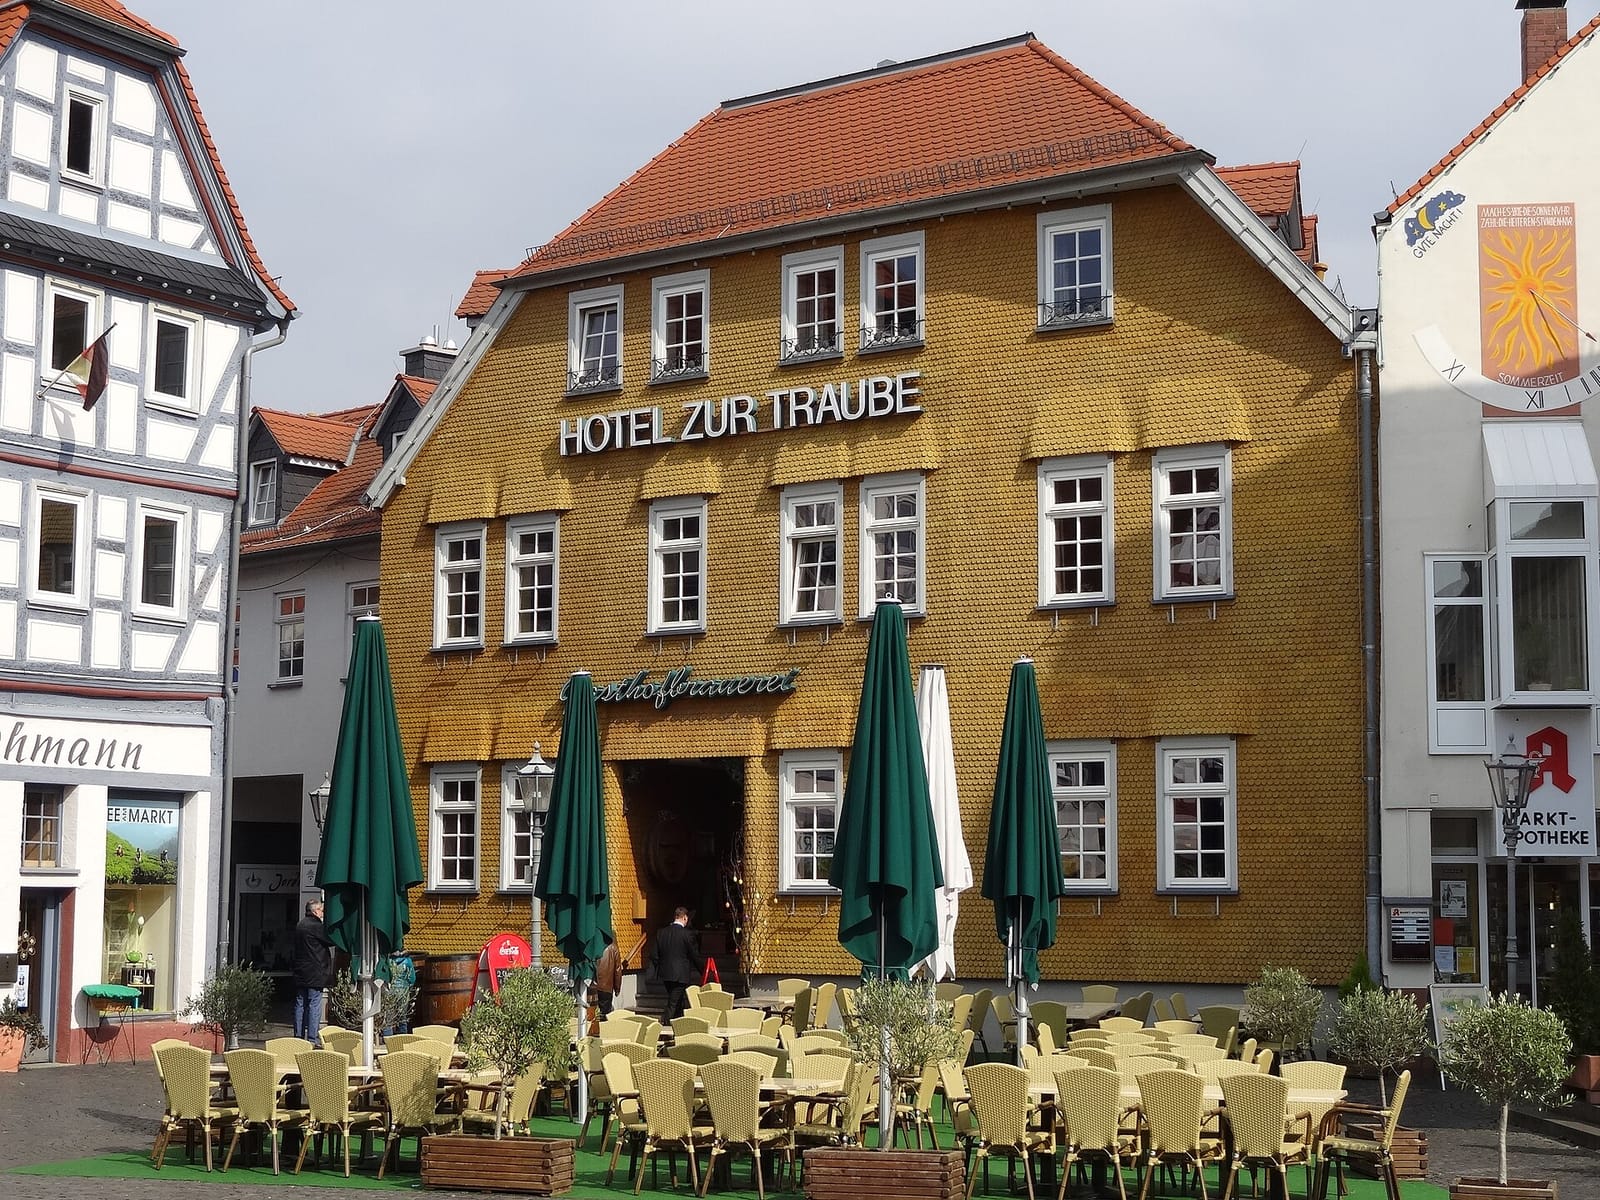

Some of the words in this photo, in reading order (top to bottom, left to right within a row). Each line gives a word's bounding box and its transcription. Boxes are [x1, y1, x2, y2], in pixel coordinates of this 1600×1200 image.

[1442, 358, 1466, 382] XI
[1497, 371, 1564, 388] SOMMERZEIT
[1525, 390, 1545, 409] XII
[559, 406, 674, 456] HOTEL
[680, 395, 758, 440] ZUR
[765, 371, 924, 429] TRAUBE
[128, 808, 174, 824] MARKT
[1502, 812, 1577, 826] ARKT-
